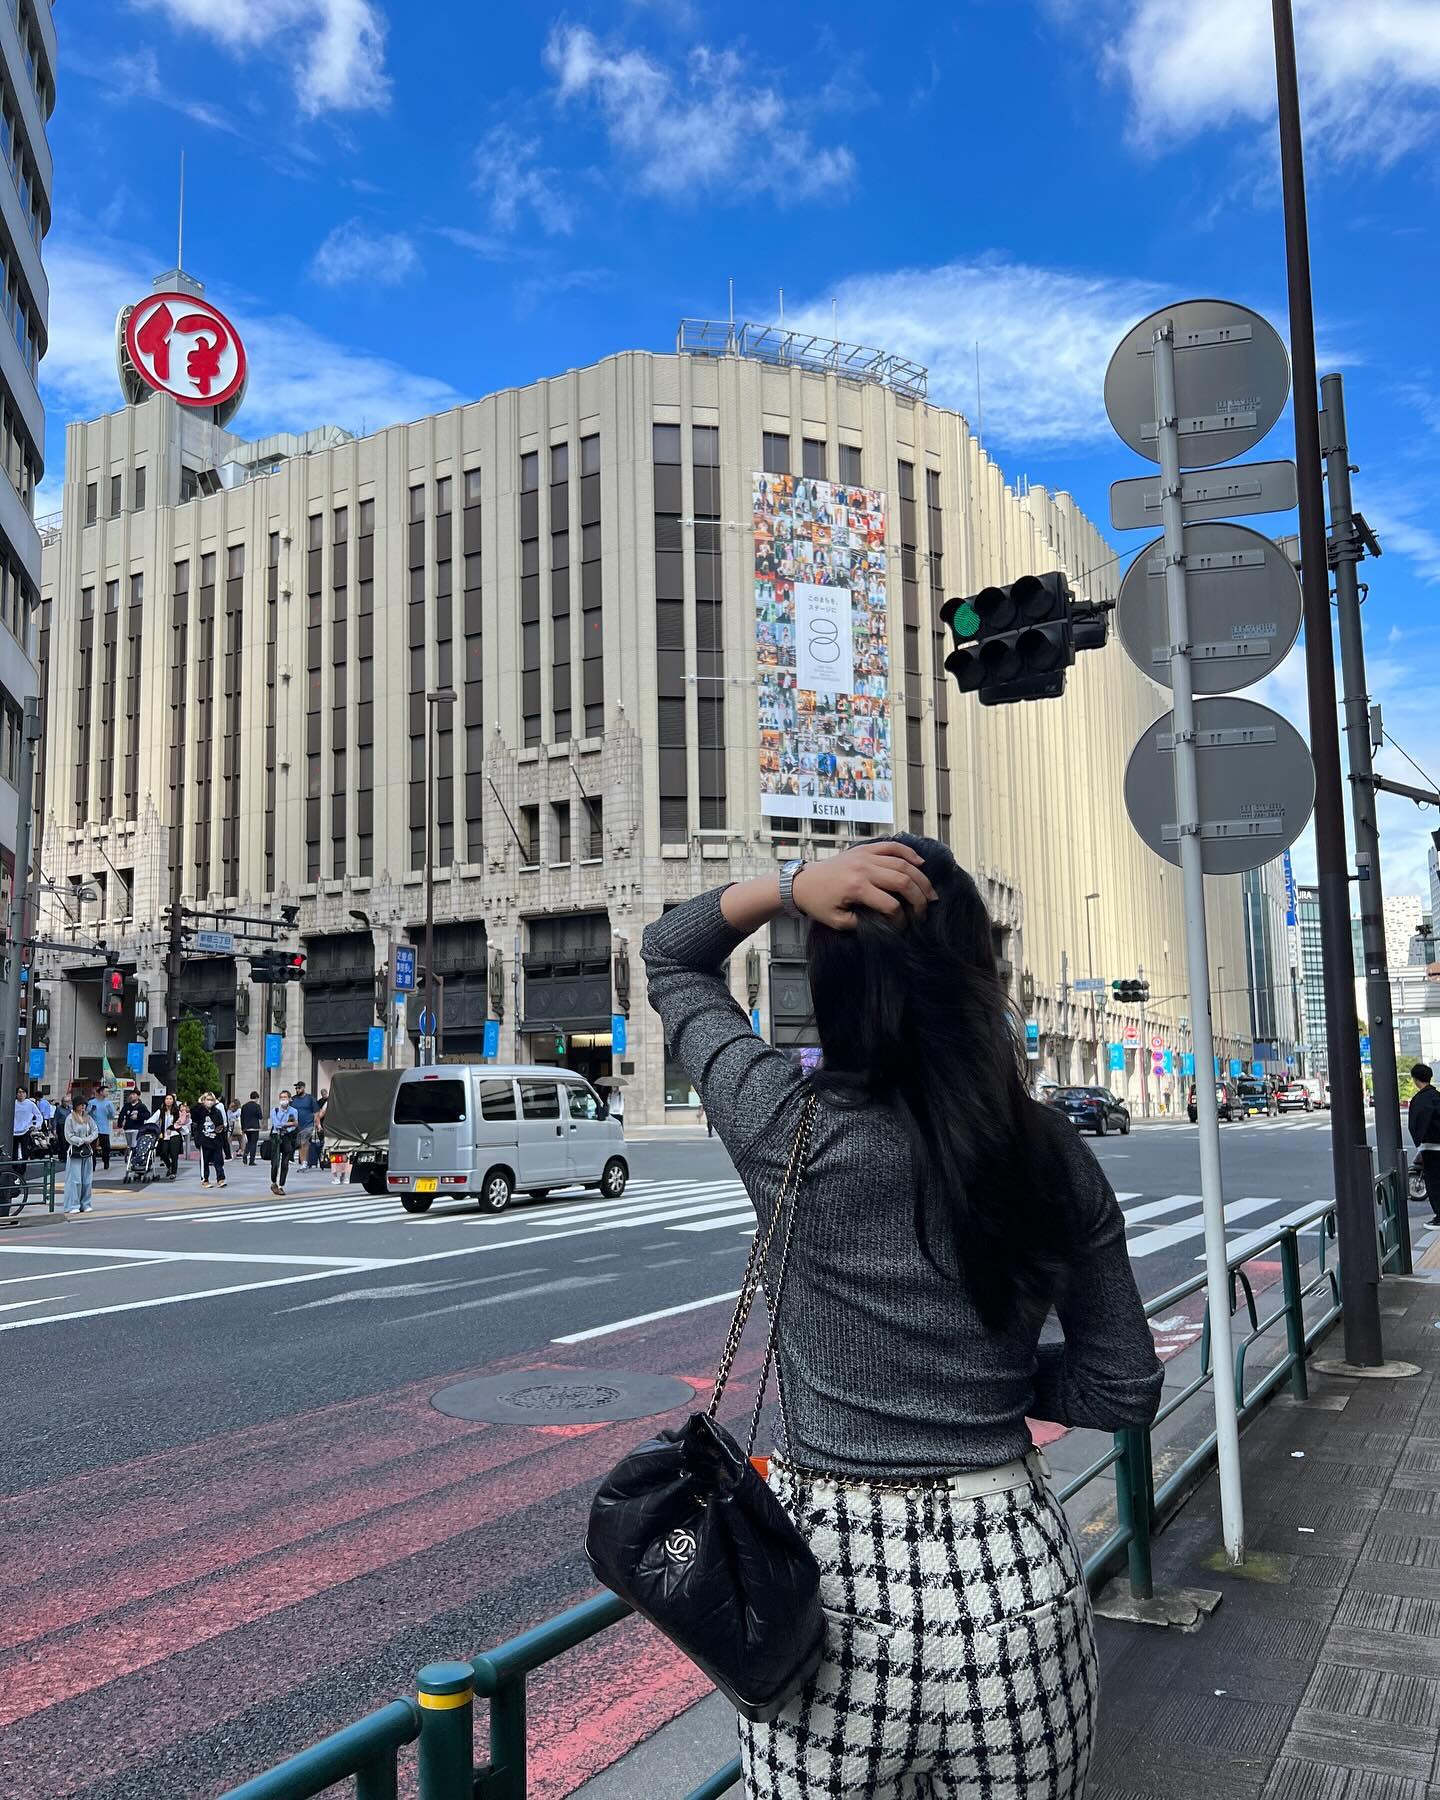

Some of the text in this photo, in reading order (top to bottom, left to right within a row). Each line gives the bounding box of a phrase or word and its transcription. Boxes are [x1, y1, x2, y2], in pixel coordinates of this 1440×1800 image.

[808, 604, 838, 614] ステージに
[812, 800, 846, 816] ISETAN
[396, 974, 412, 985] 注意
